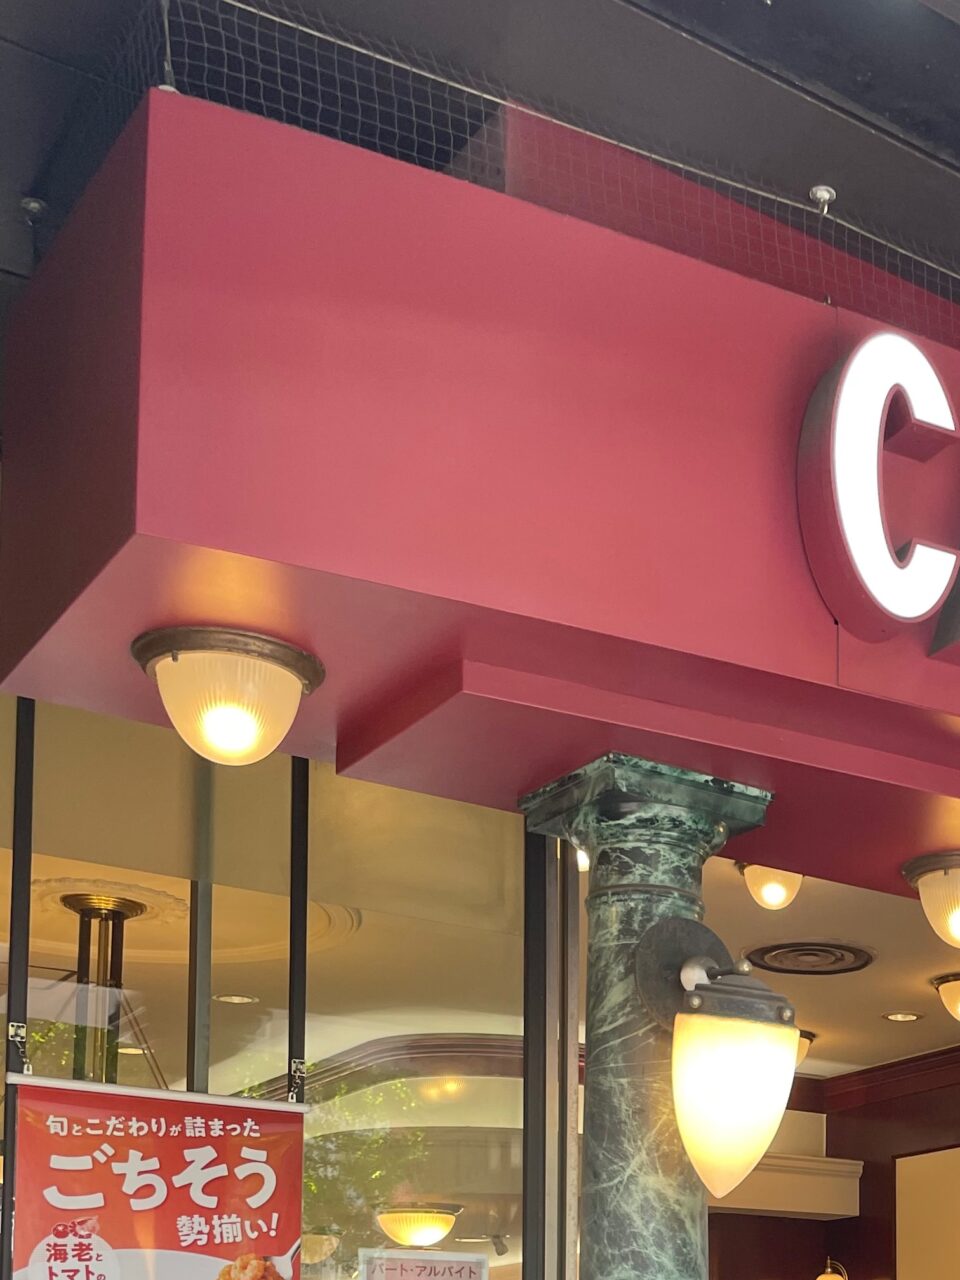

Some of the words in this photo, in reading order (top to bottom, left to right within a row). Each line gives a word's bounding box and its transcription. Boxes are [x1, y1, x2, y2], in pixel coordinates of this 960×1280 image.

[46, 1114, 261, 1138] 旬とこだわりが詰まった
[42, 1143, 278, 1211] ごちそう
[176, 1213, 279, 1247] 勢揃い!
[46, 1241, 104, 1263] 海老と
